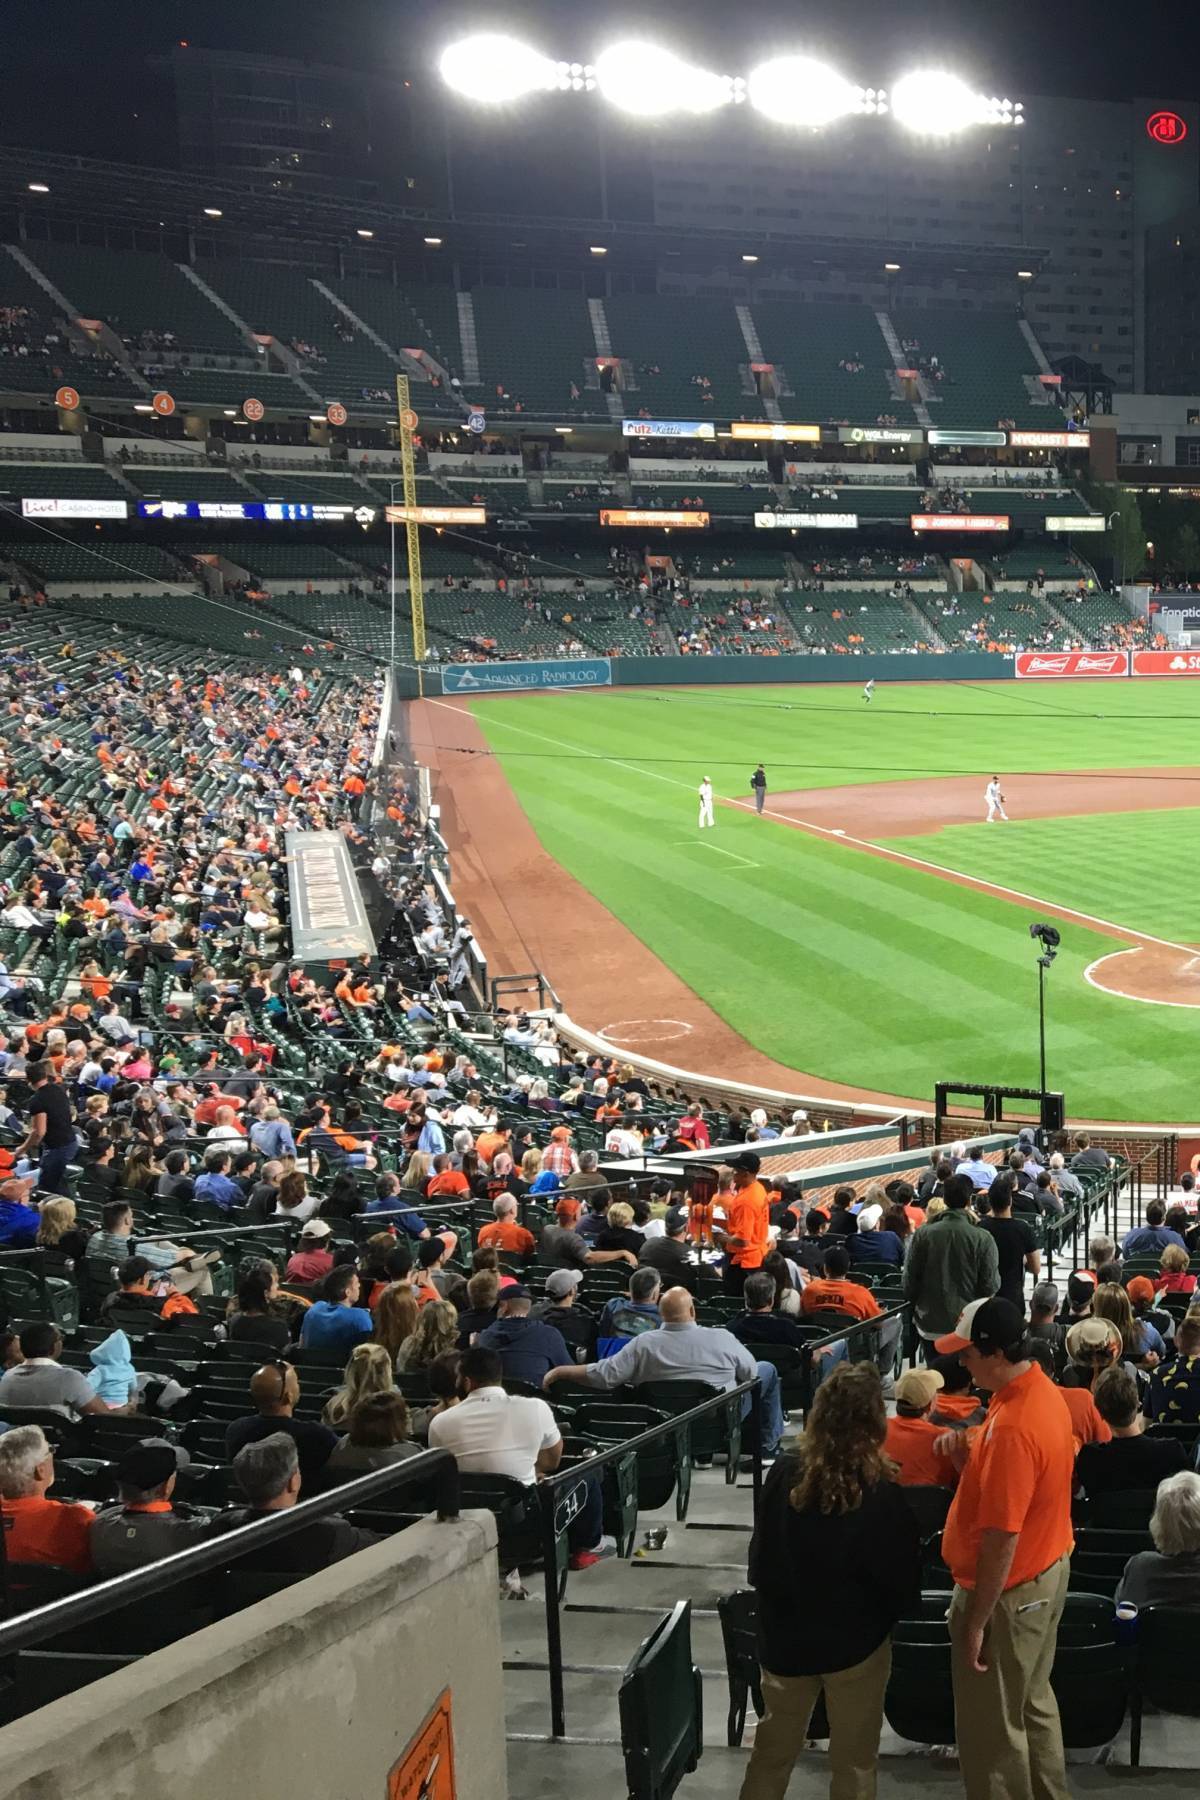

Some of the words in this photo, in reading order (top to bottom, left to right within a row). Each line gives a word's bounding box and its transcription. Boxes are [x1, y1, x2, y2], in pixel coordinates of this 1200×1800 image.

[64, 392, 73, 404] 5
[159, 399, 168, 409] 4
[246, 404, 262, 416] 22
[470, 418, 484, 429] 42
[541, 669, 599, 683] RADIOLOGY
[564, 1492, 578, 1524] 34
